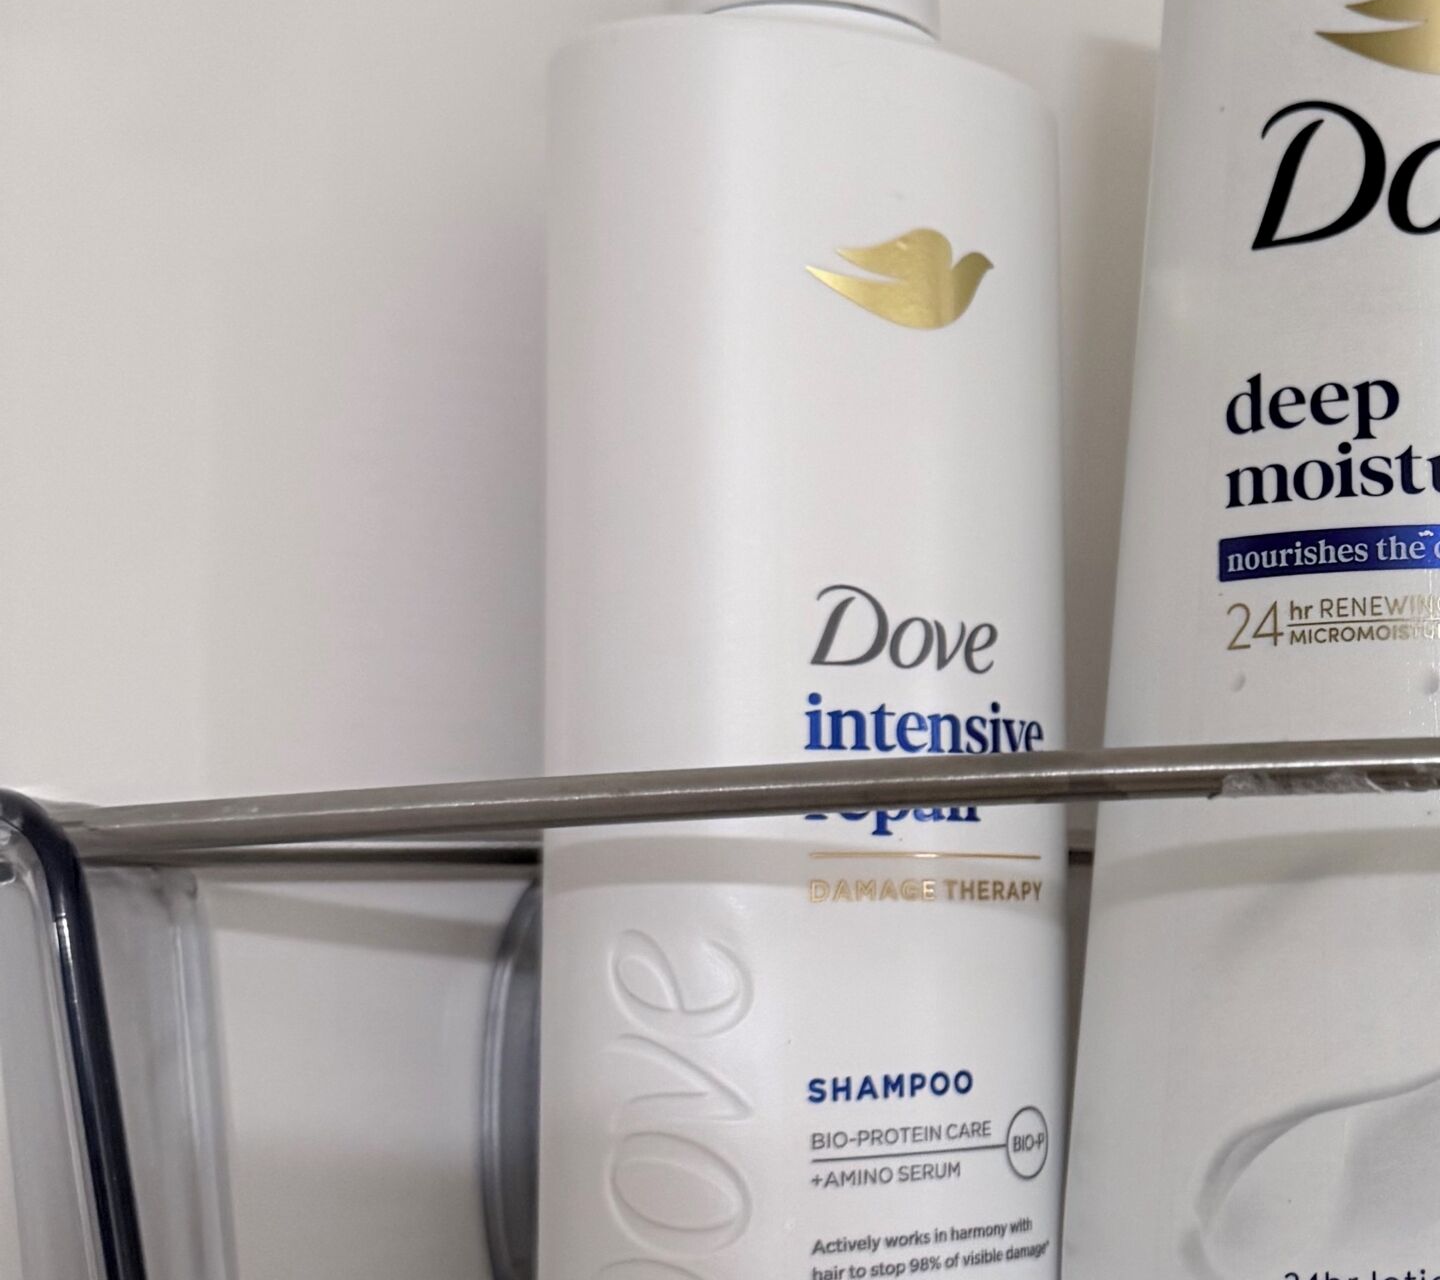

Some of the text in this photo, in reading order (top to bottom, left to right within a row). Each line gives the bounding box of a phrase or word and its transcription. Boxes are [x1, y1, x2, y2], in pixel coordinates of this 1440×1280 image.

[1225, 373, 1400, 440] deep
[1226, 539, 1369, 573] nourishes
[1375, 536, 1426, 563] the
[810, 583, 999, 674] Dove
[1226, 600, 1284, 651] 24
[1290, 600, 1314, 620] hr
[804, 692, 1044, 754] intensive
[809, 879, 1043, 903] DAMAGE THERAPY
[807, 1069, 974, 1104] SHAMPOO
[811, 1120, 992, 1151] BIO-PROTEIN CARE
[1012, 1131, 1046, 1153] BIO-P
[810, 1161, 962, 1189] +AMINO SERUM
[810, 1218, 1033, 1256] Actively works in harmony with
[849, 1265, 867, 1280] to
[870, 1261, 906, 1279] stop
[909, 1256, 942, 1273] 98%
[945, 1255, 959, 1269] of
[962, 1248, 1003, 1266] visible
